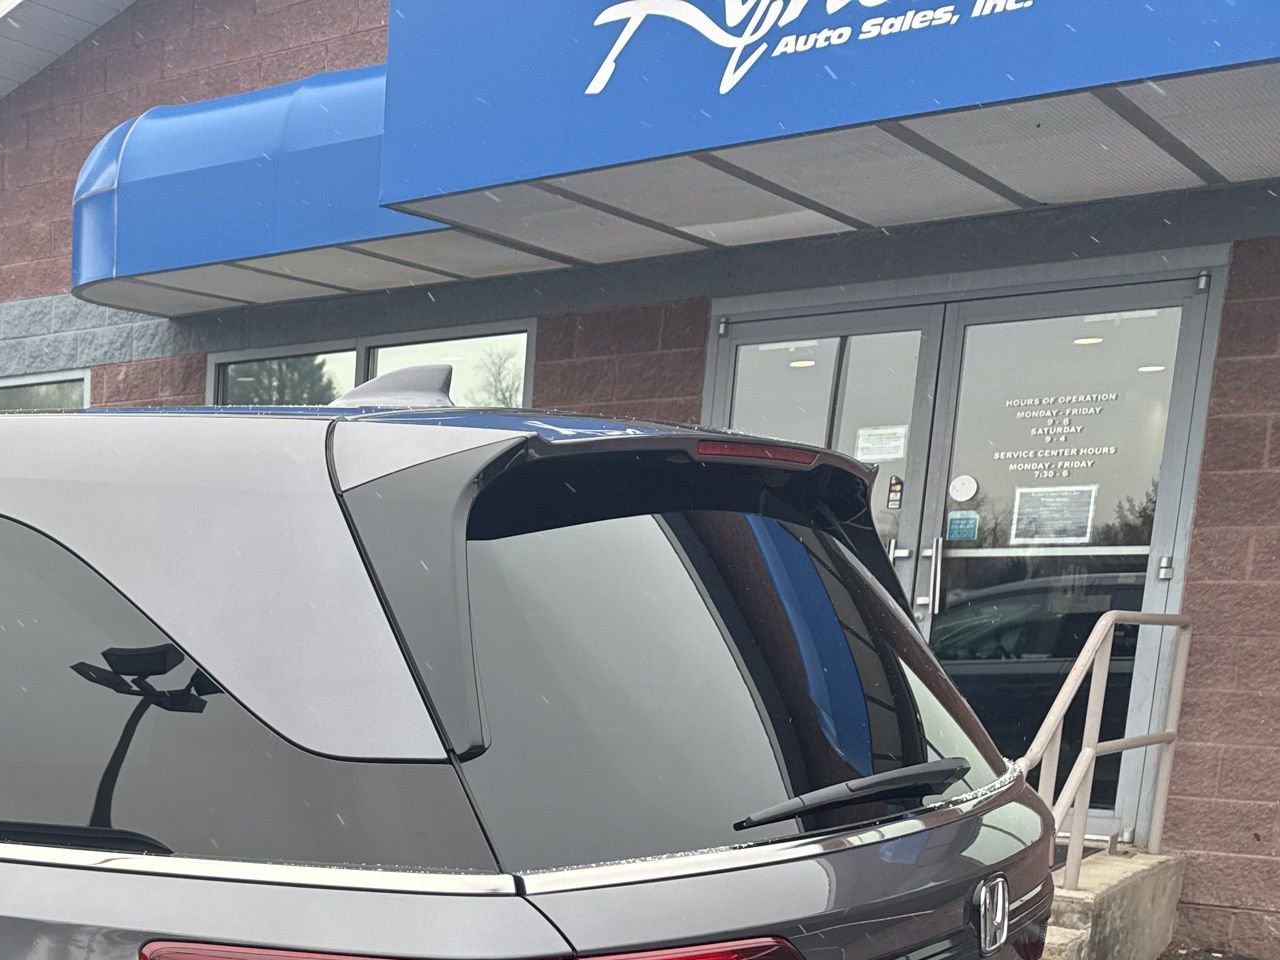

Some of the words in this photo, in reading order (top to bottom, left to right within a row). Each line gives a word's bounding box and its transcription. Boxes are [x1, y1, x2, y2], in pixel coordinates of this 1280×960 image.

[771, 26, 852, 57] Auto
[858, 5, 960, 40] Sales,
[1005, 397, 1040, 407] HOURS
[1042, 396, 1056, 405] OF
[1058, 393, 1117, 404] OPERATION
[1016, 409, 1058, 419] MONDAY
[1065, 406, 1102, 416] FRIDAY
[1047, 418, 1054, 426] 9
[1030, 425, 1083, 436] SATURDAY
[1045, 435, 1052, 443] 9
[993, 450, 1035, 459] SERVICE
[1037, 448, 1078, 457] CENTER
[1079, 446, 1116, 455] HOURS
[1008, 462, 1050, 471] MONDAY
[1057, 460, 1094, 469] FRIDAY
[1033, 470, 1054, 478] 7:30
